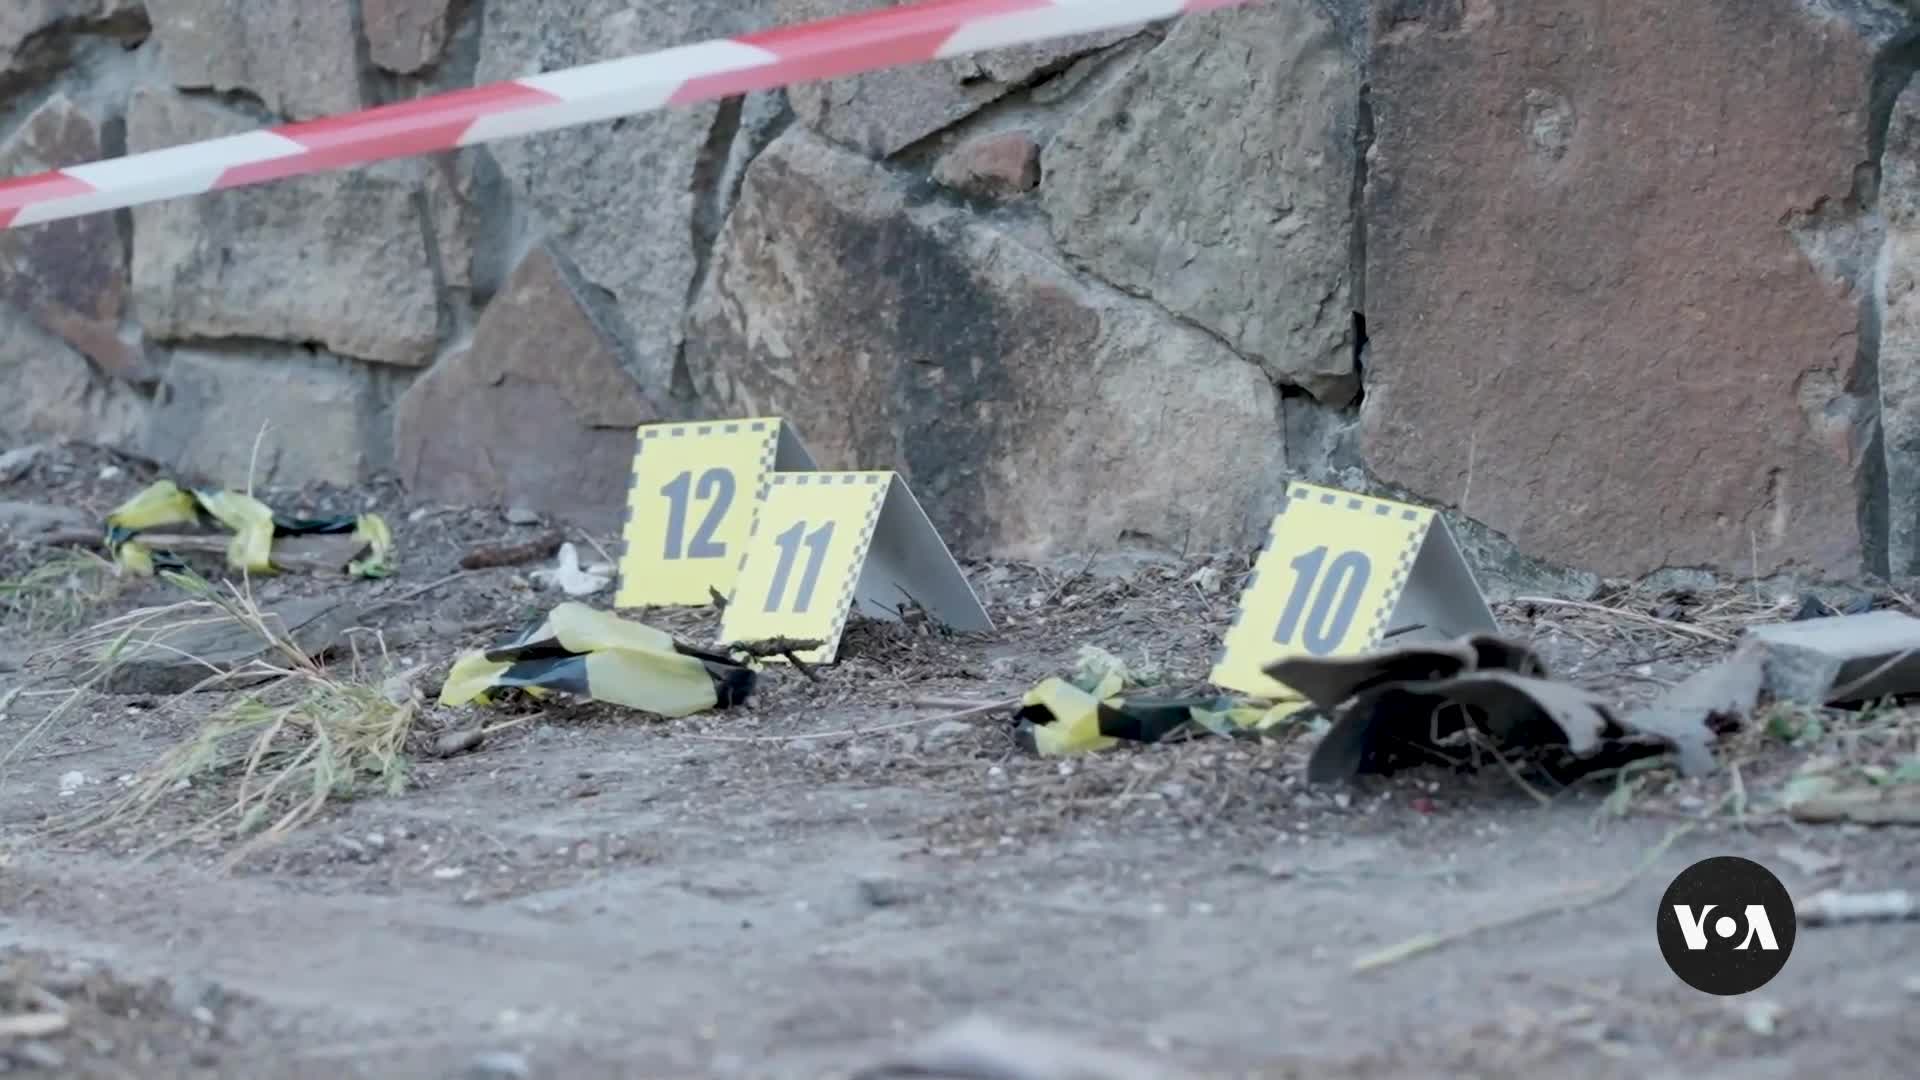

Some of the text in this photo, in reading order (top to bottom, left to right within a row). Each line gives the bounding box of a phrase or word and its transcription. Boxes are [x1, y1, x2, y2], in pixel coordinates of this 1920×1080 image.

[661, 467, 736, 560] 12
[763, 520, 836, 613] 11
[1272, 545, 1371, 657] 10
